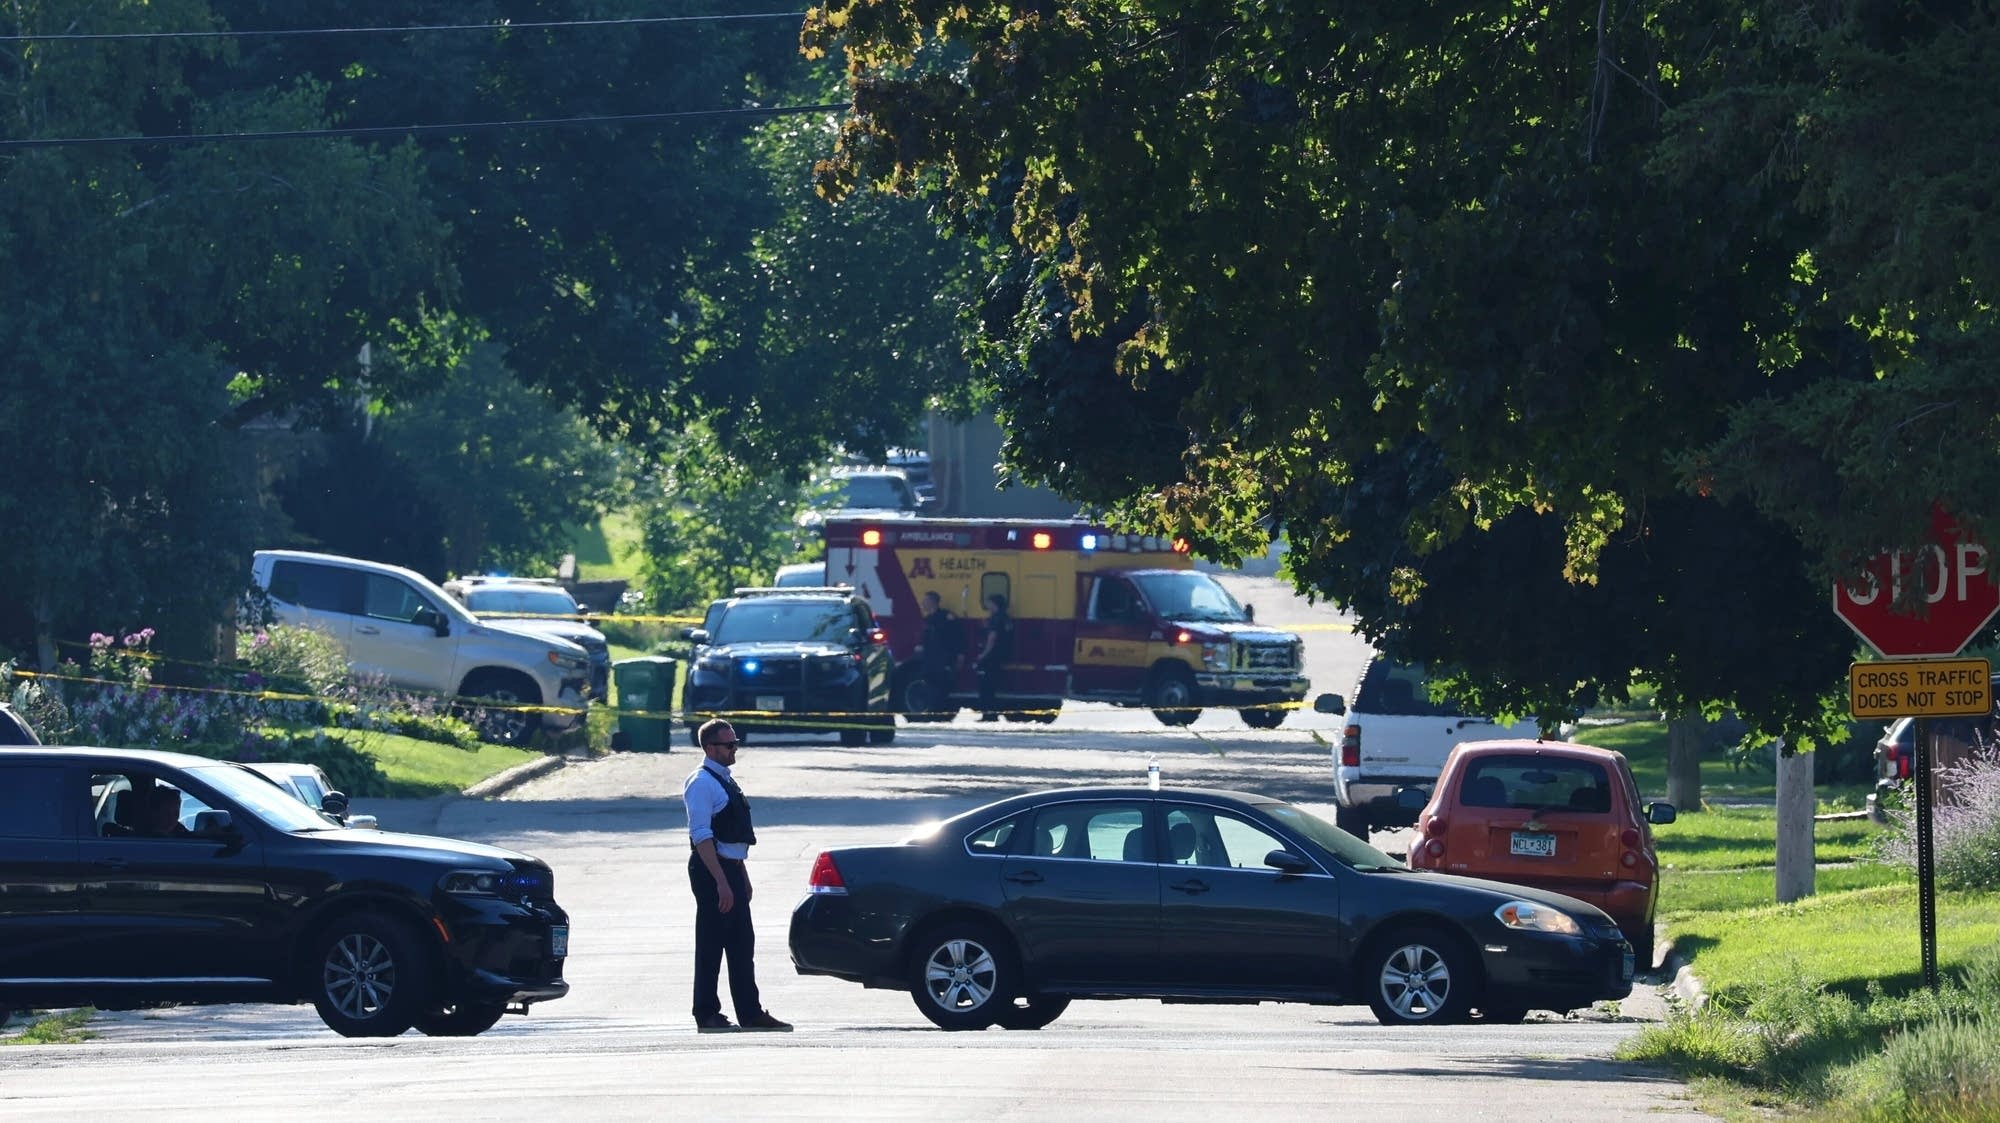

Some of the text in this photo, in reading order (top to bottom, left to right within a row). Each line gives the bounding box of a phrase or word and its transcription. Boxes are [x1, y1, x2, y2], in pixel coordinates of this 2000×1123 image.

[939, 557, 987, 571] HEALTH
[1858, 669, 1983, 688] CROSS TRAFFIC
[1858, 690, 1984, 709] DOES NOT STOP
